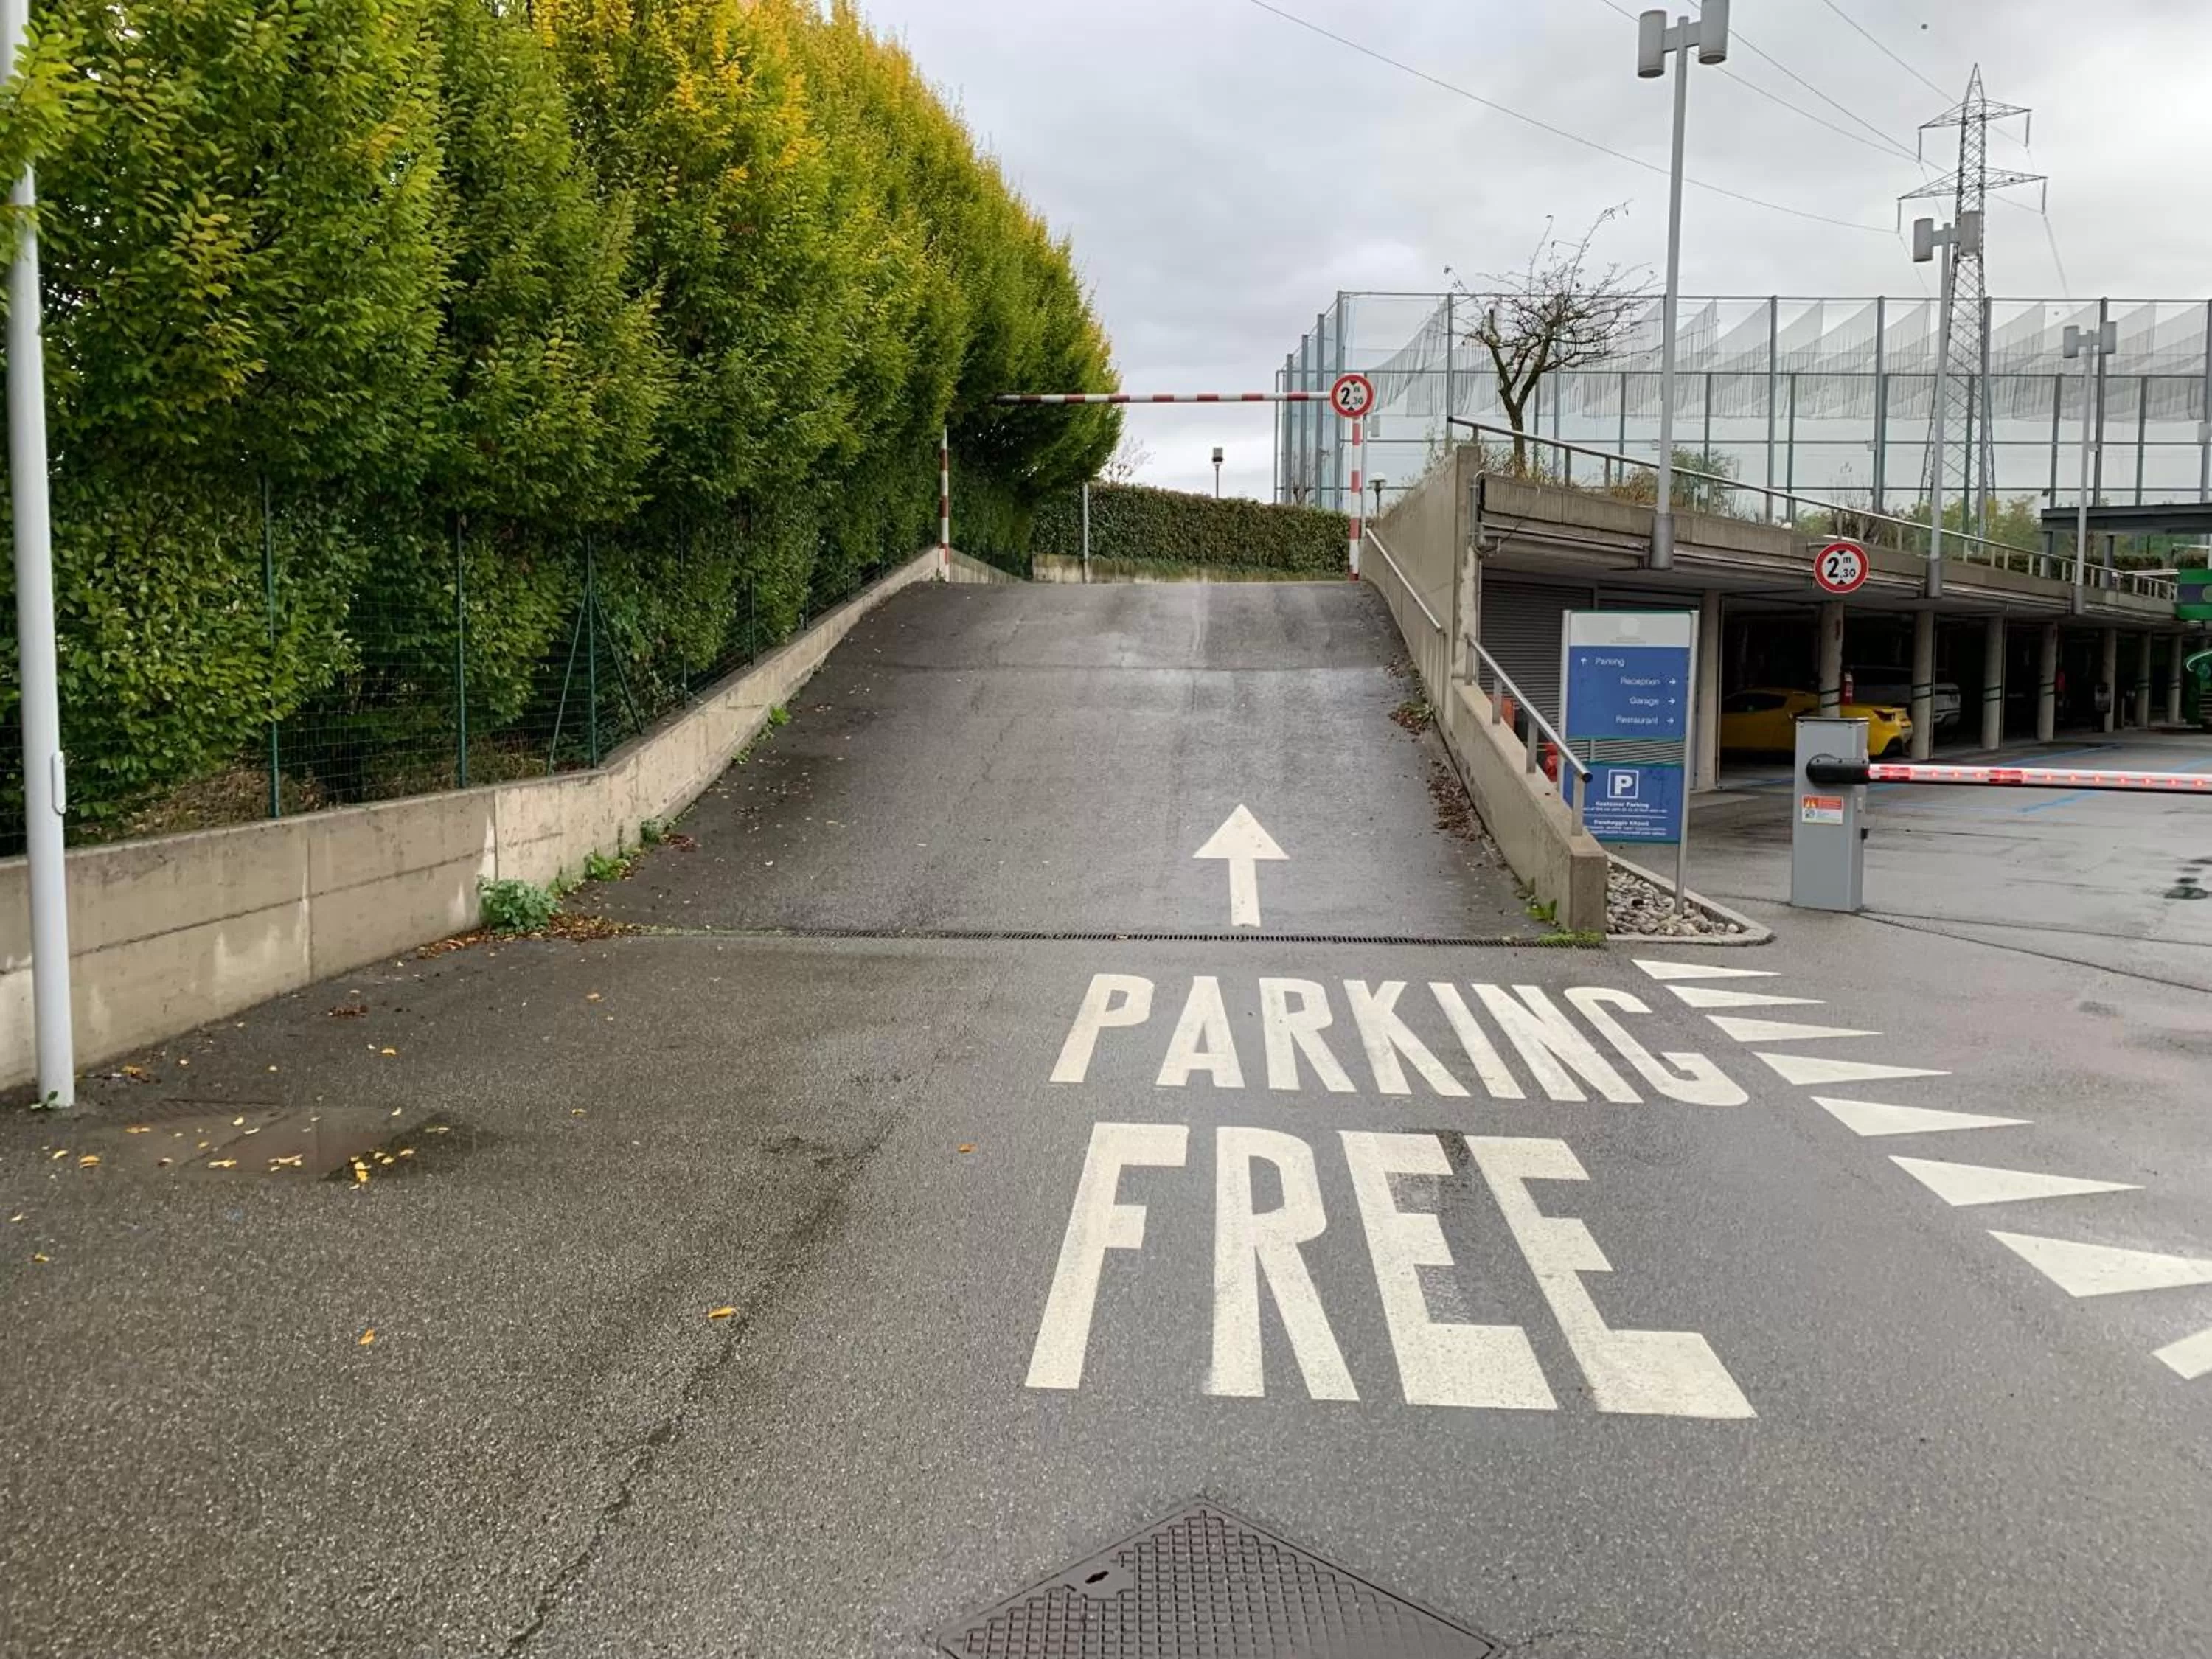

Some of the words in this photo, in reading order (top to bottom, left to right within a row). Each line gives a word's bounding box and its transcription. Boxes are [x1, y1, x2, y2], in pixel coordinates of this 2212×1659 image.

[1340, 387, 1350, 405] 2
[1826, 557, 1839, 578] 2
[1595, 657, 1625, 667] Parking
[1620, 677, 1660, 686] Reception
[1629, 696, 1659, 707] Garage
[1615, 714, 1658, 725] Restaurant
[1614, 775, 1634, 796] P
[1048, 973, 1750, 1107] PARKING
[1023, 1121, 1758, 1419] FREE
